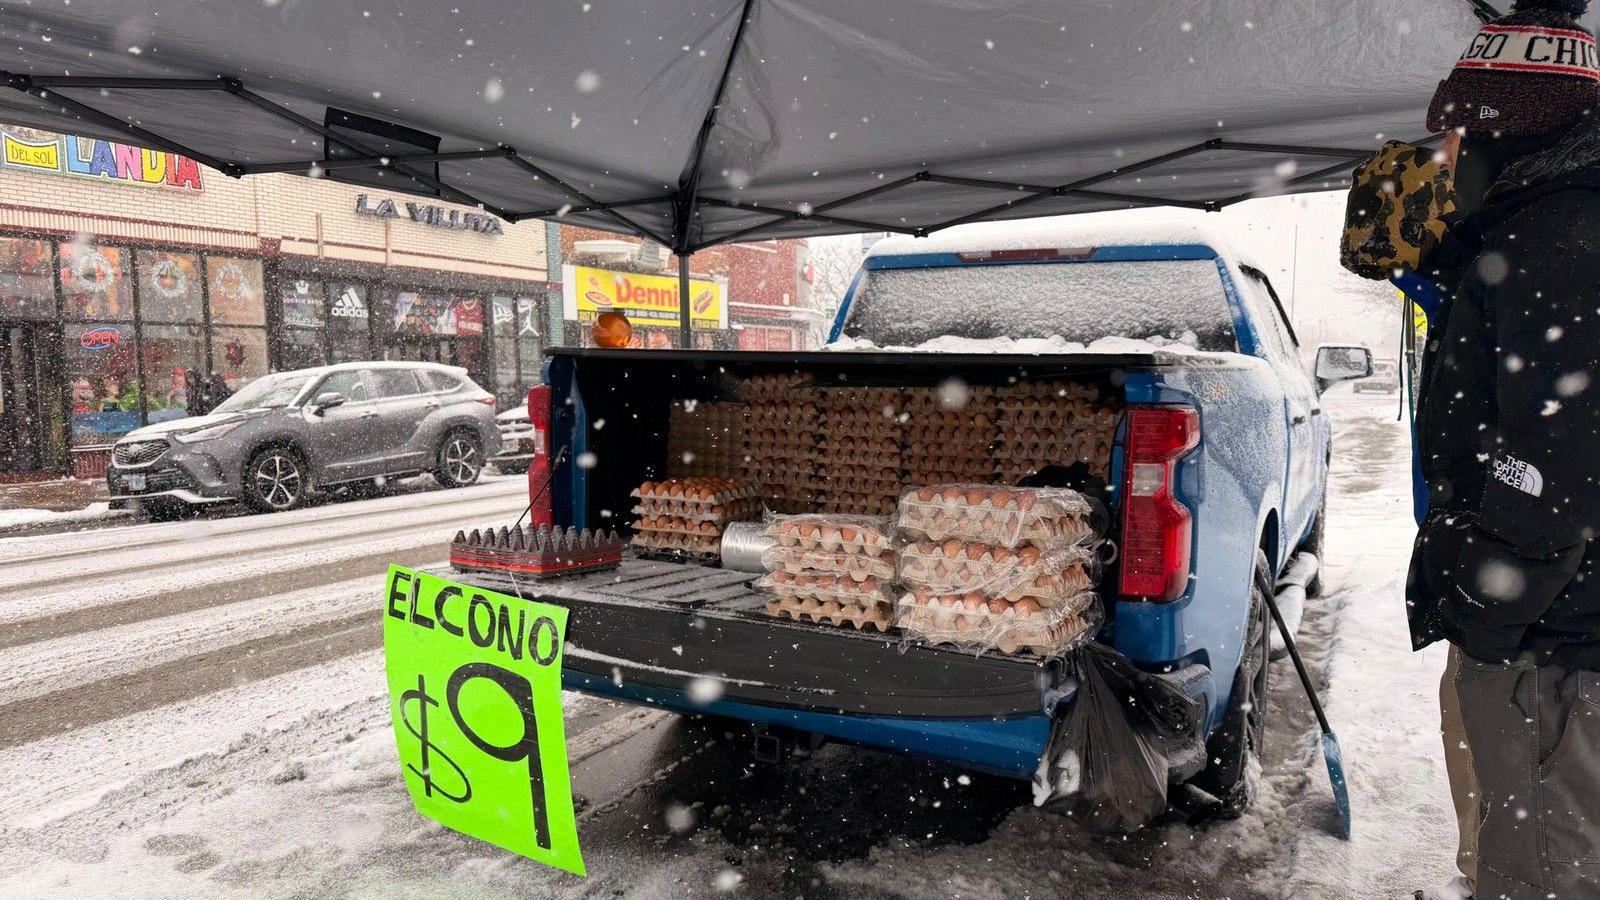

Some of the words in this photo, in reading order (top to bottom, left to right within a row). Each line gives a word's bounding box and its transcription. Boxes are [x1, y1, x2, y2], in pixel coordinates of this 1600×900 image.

[11, 145, 31, 161] DEL
[33, 151, 53, 165] SOL
[65, 134, 203, 190] LANDIA
[356, 193, 400, 219] LA
[405, 202, 504, 236] VILLITA
[615, 275, 679, 308] Denni
[331, 306, 369, 319] adidas
[80, 330, 119, 347] OPEN
[1506, 454, 1527, 472] THE
[1494, 470, 1521, 489] FACE
[388, 571, 560, 667] ELCONO
[400, 661, 552, 850] $9
